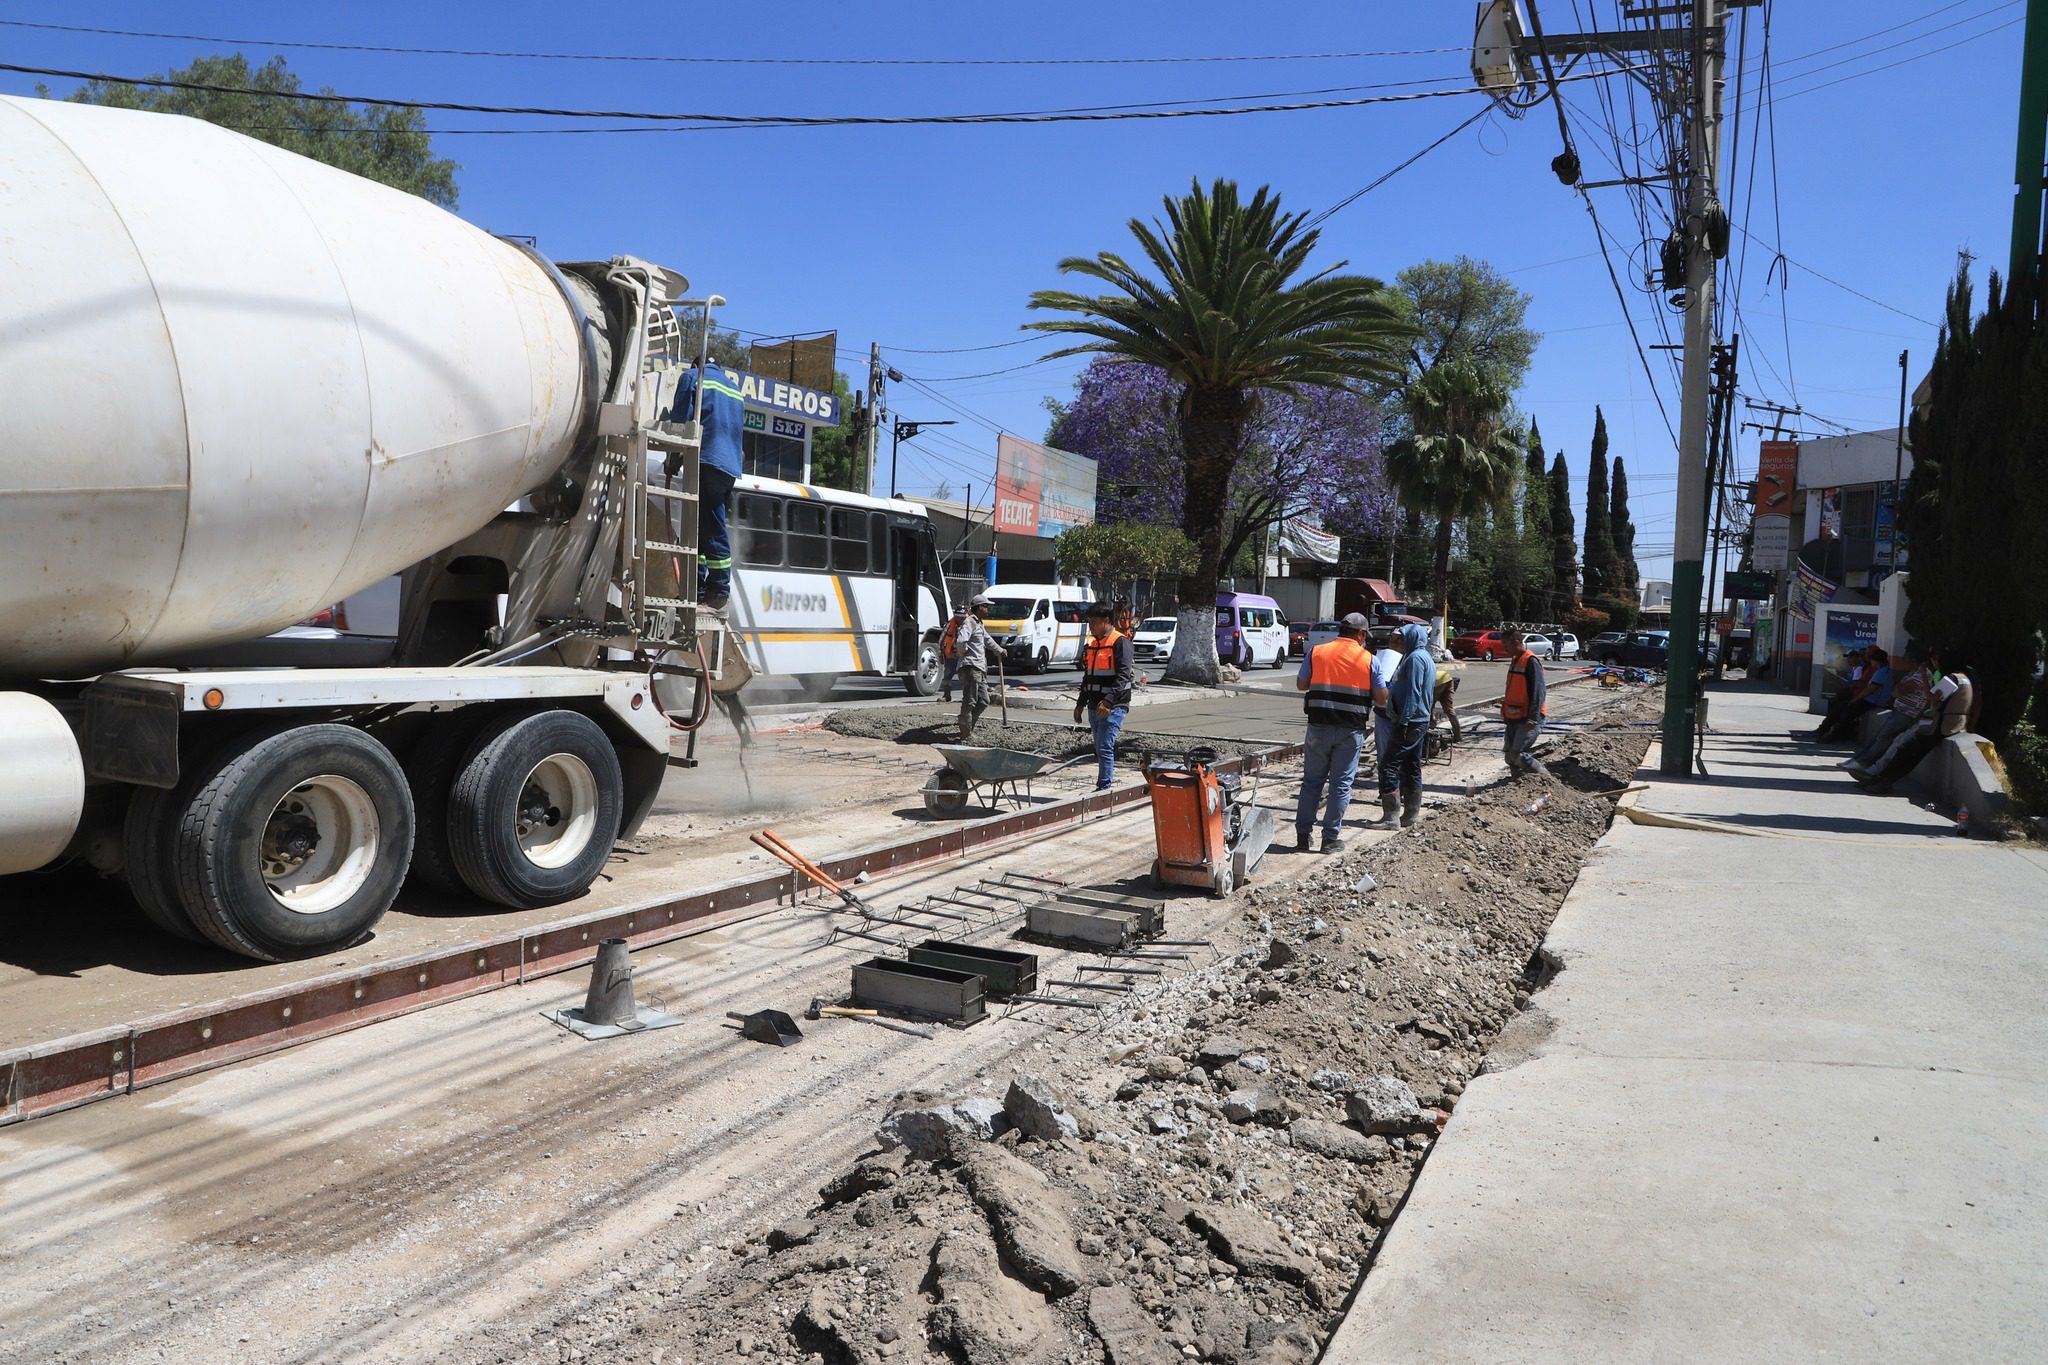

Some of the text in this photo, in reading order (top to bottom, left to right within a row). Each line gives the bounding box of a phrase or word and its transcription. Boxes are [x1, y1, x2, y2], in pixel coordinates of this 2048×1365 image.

[775, 419, 803, 436] SKF
[1761, 463, 1794, 471] seguros
[999, 498, 1034, 528] TECATE
[773, 586, 827, 612] Aurora
[1856, 620, 1868, 628] Ya
